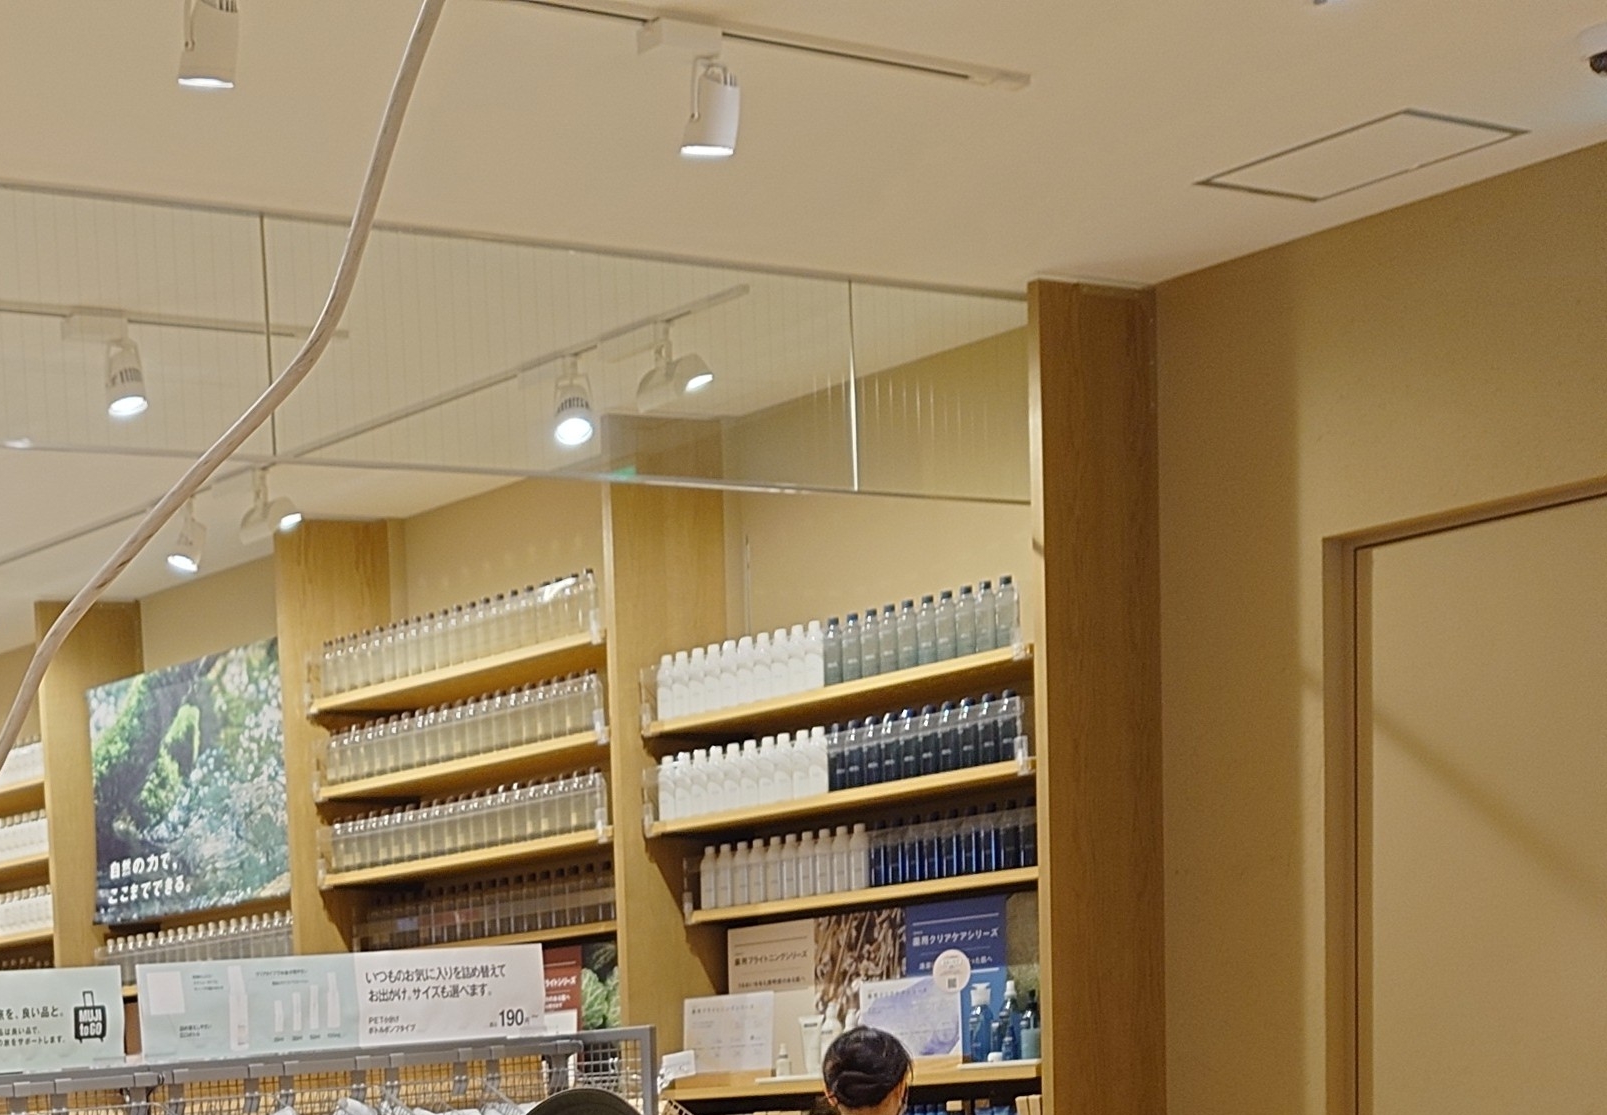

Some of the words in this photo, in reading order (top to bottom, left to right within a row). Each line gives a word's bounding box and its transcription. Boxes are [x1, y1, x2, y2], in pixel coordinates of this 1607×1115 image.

[107, 874, 192, 904] ここまでできる。
[365, 964, 507, 983] いつものお気に入りを詰め替えて
[78, 1008, 103, 1023] MUJI
